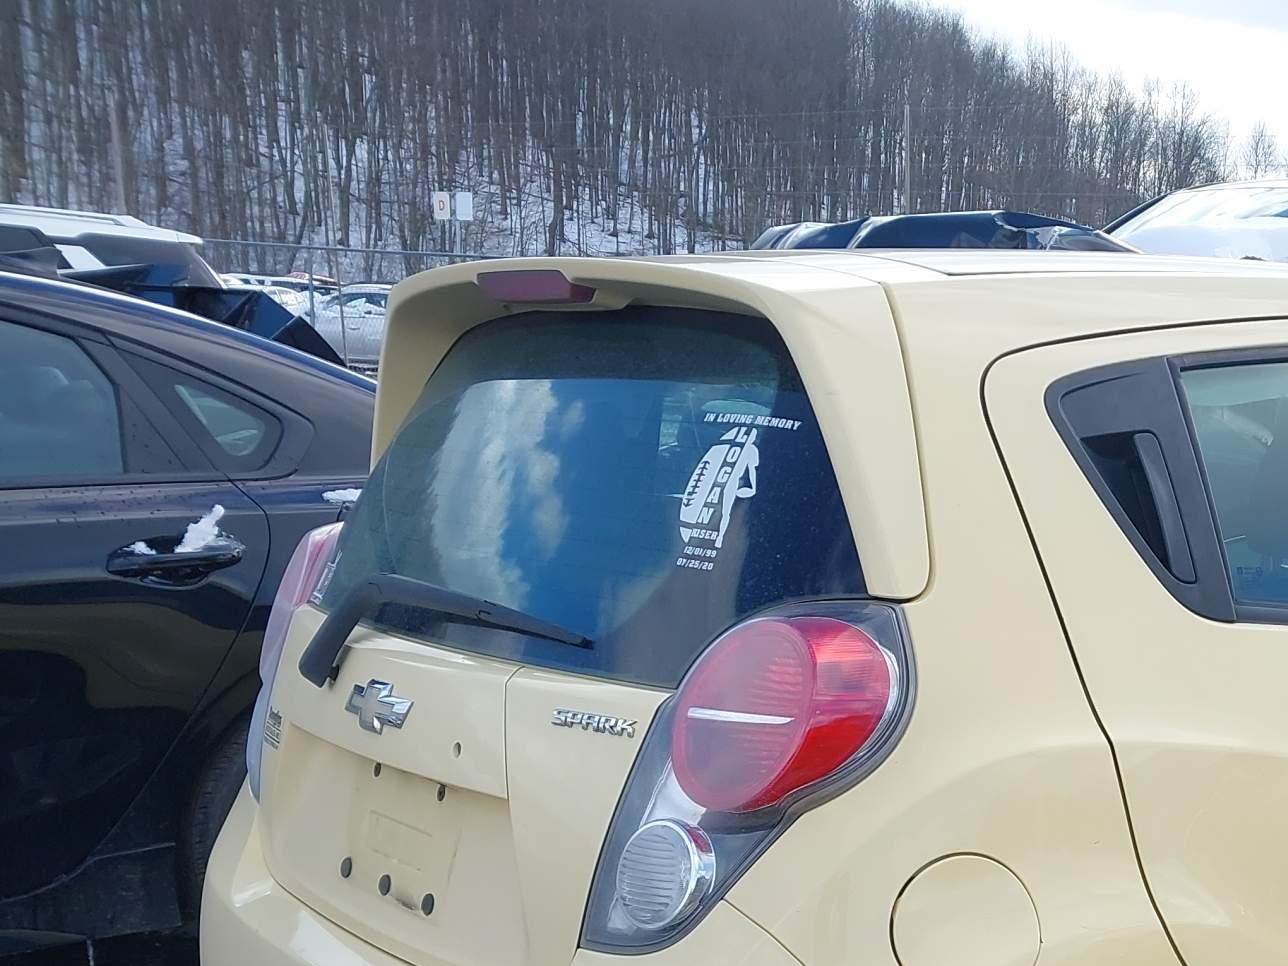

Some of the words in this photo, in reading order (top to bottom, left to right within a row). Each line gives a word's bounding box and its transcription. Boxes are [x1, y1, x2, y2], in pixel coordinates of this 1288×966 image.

[438, 199, 446, 211] D
[703, 412, 716, 422] IN
[717, 413, 754, 424] LOVING
[755, 415, 802, 430] MEMORY
[683, 546, 717, 558] 12/01/99
[676, 557, 714, 571] 07/25/20
[551, 708, 638, 738] SPARK
